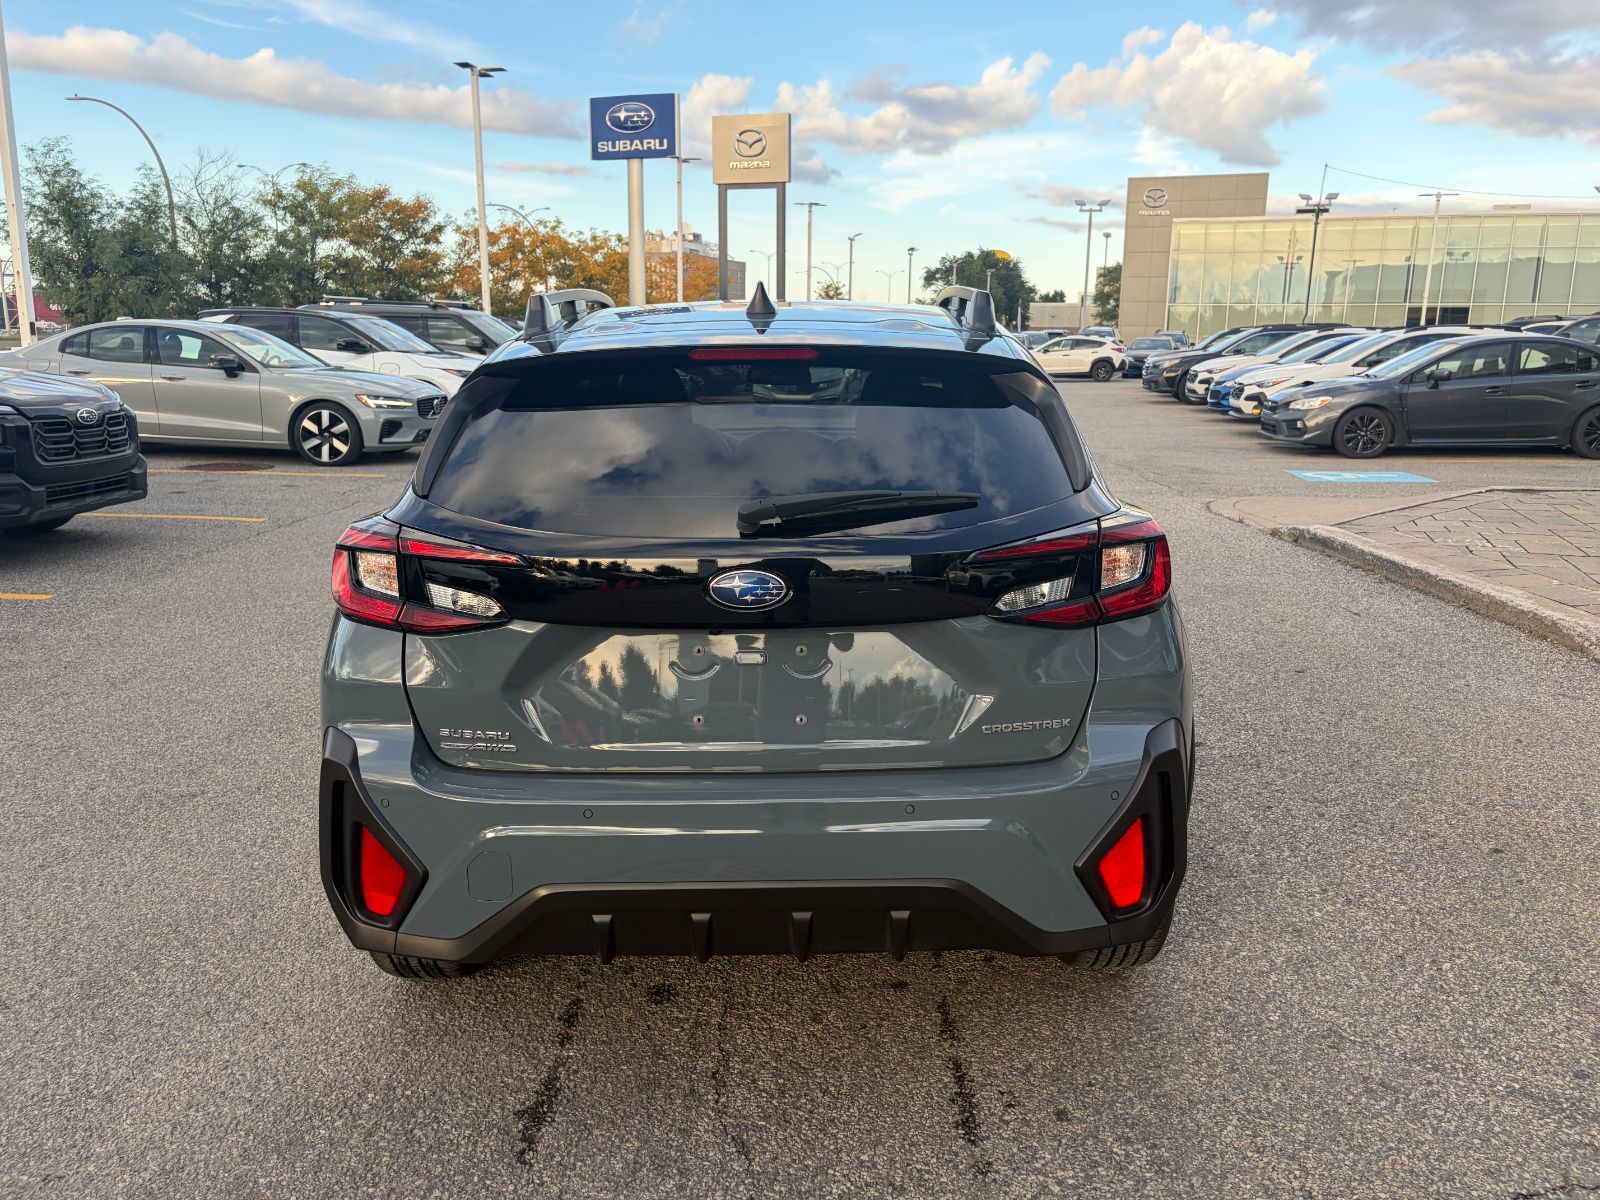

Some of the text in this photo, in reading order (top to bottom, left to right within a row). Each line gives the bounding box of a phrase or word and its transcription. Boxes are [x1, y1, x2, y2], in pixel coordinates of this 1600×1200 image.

[597, 138, 668, 153] SUBARU
[729, 160, 771, 170] mazda
[981, 718, 1072, 734] CROSSTREK
[439, 728, 510, 740] SUBARU
